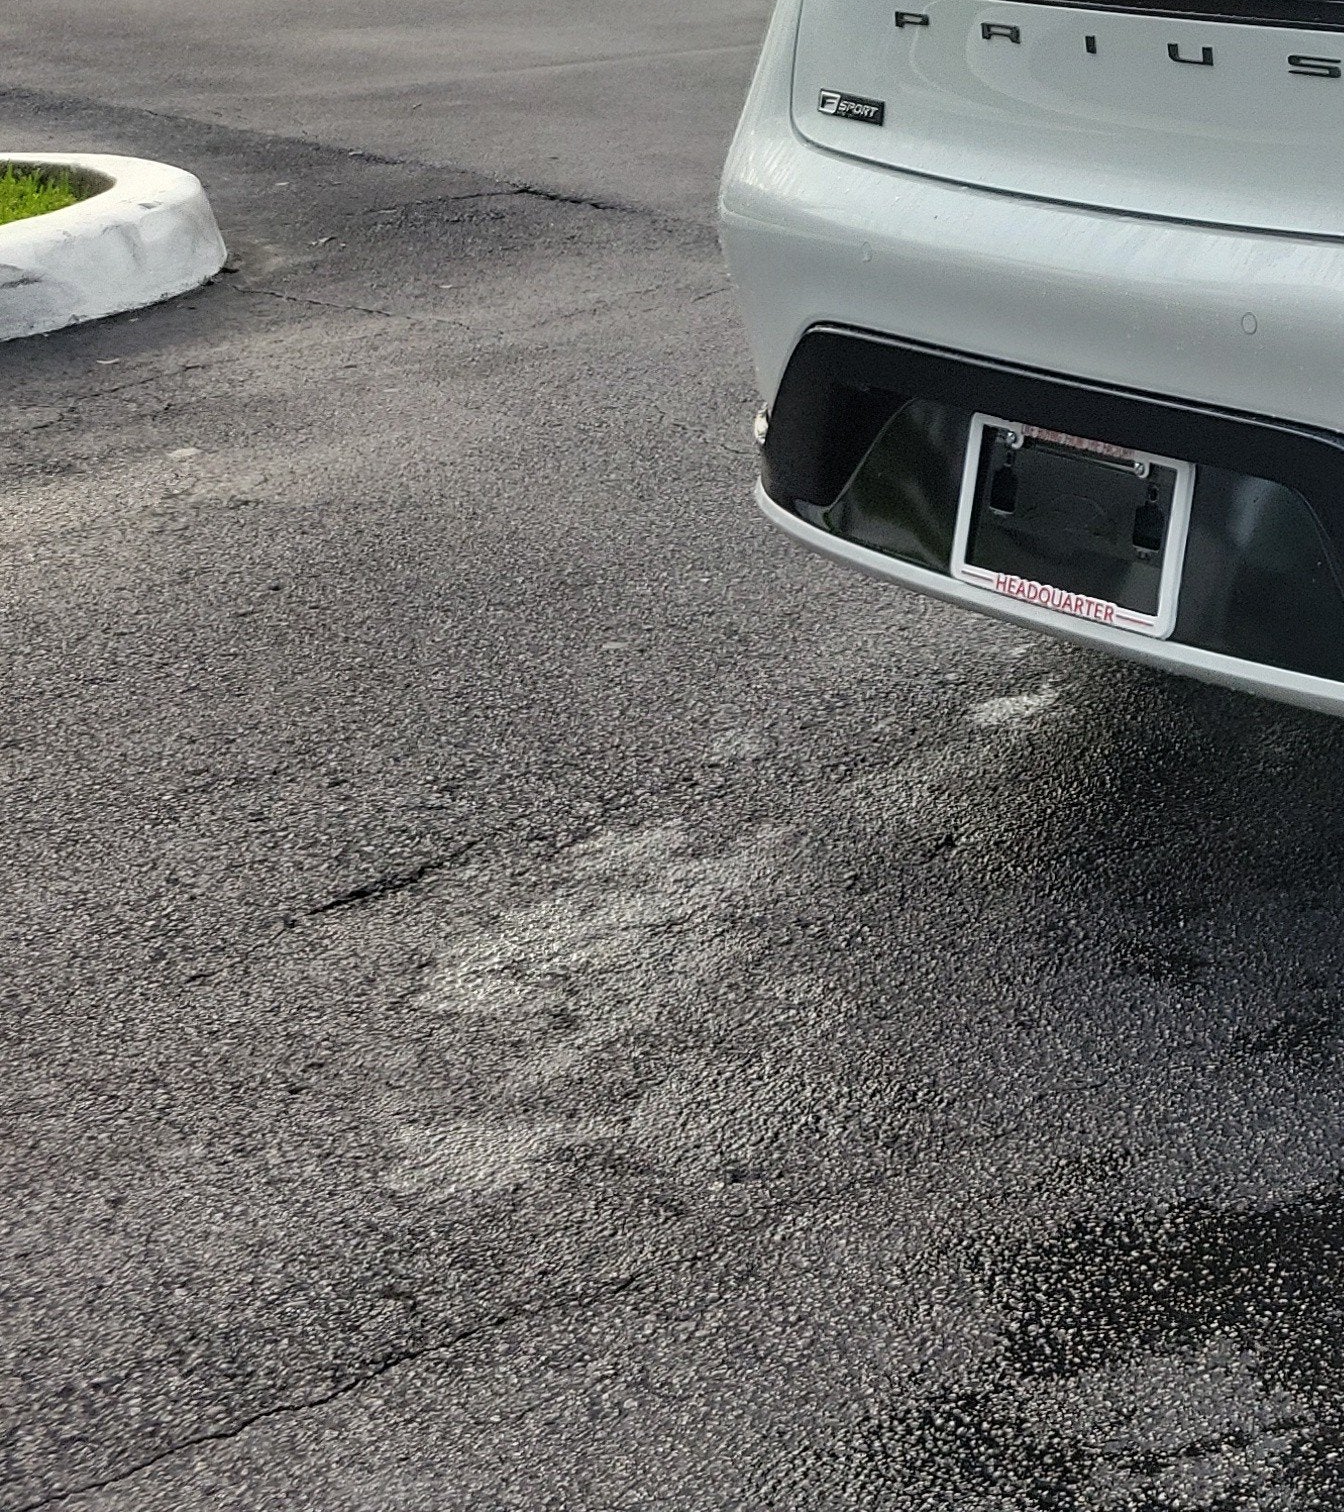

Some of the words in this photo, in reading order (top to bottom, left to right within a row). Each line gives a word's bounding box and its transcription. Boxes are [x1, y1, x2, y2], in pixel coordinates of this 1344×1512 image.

[895, 11, 1341, 79] PRIUS
[838, 100, 879, 118] SPORT
[994, 574, 1115, 623] HEADQUARTER
